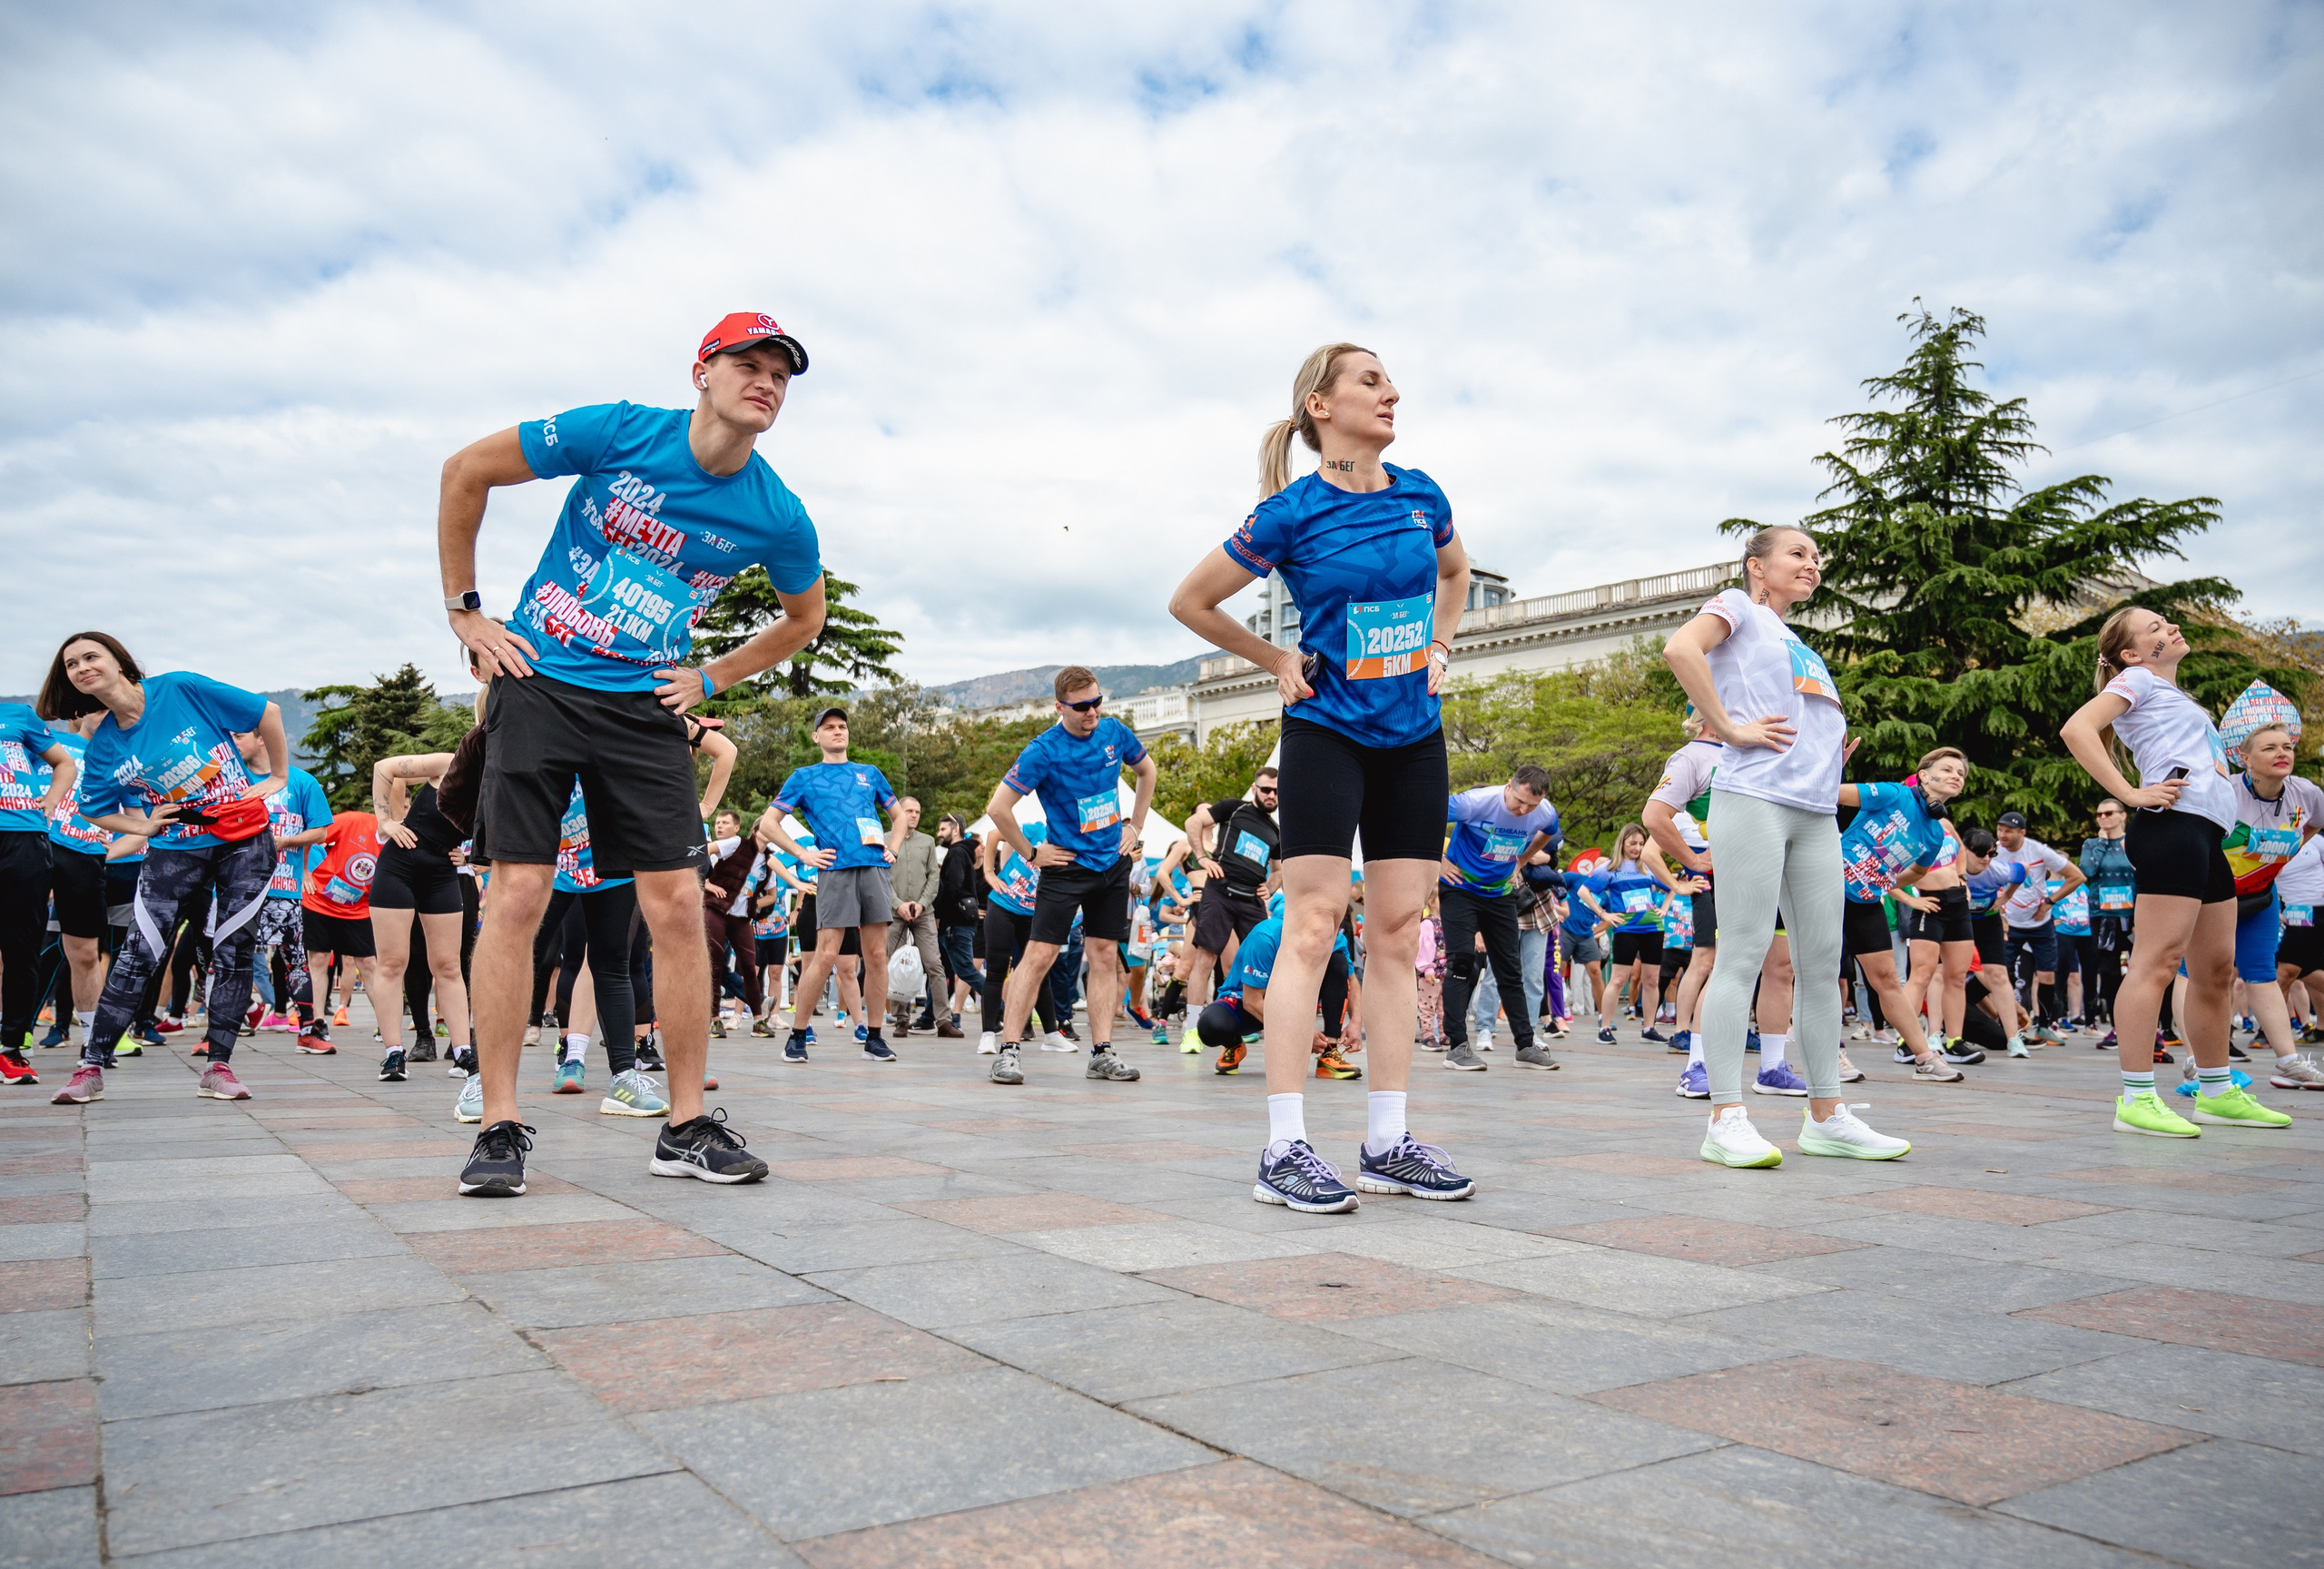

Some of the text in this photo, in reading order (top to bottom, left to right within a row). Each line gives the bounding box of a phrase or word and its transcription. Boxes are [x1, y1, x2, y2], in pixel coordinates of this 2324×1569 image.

[607, 470, 666, 517] 2024
[603, 498, 687, 558] #МЕЧТА
[625, 553, 641, 566] ПСБ
[536, 580, 617, 648] #ЛЮБОВЬ
[611, 577, 675, 626] 40195
[603, 603, 655, 643] 21.1КМ
[1367, 620, 1423, 654] 20252
[1383, 653, 1412, 677] 5КМ
[113, 755, 143, 787] 2024
[157, 755, 202, 788] 20366
[181, 774, 205, 795] 5КМ
[1, 783, 32, 797] 2024
[1494, 827, 1528, 836] ГЕНБАНК
[2257, 840, 2290, 854] 20001
[1492, 844, 1518, 855] 30271
